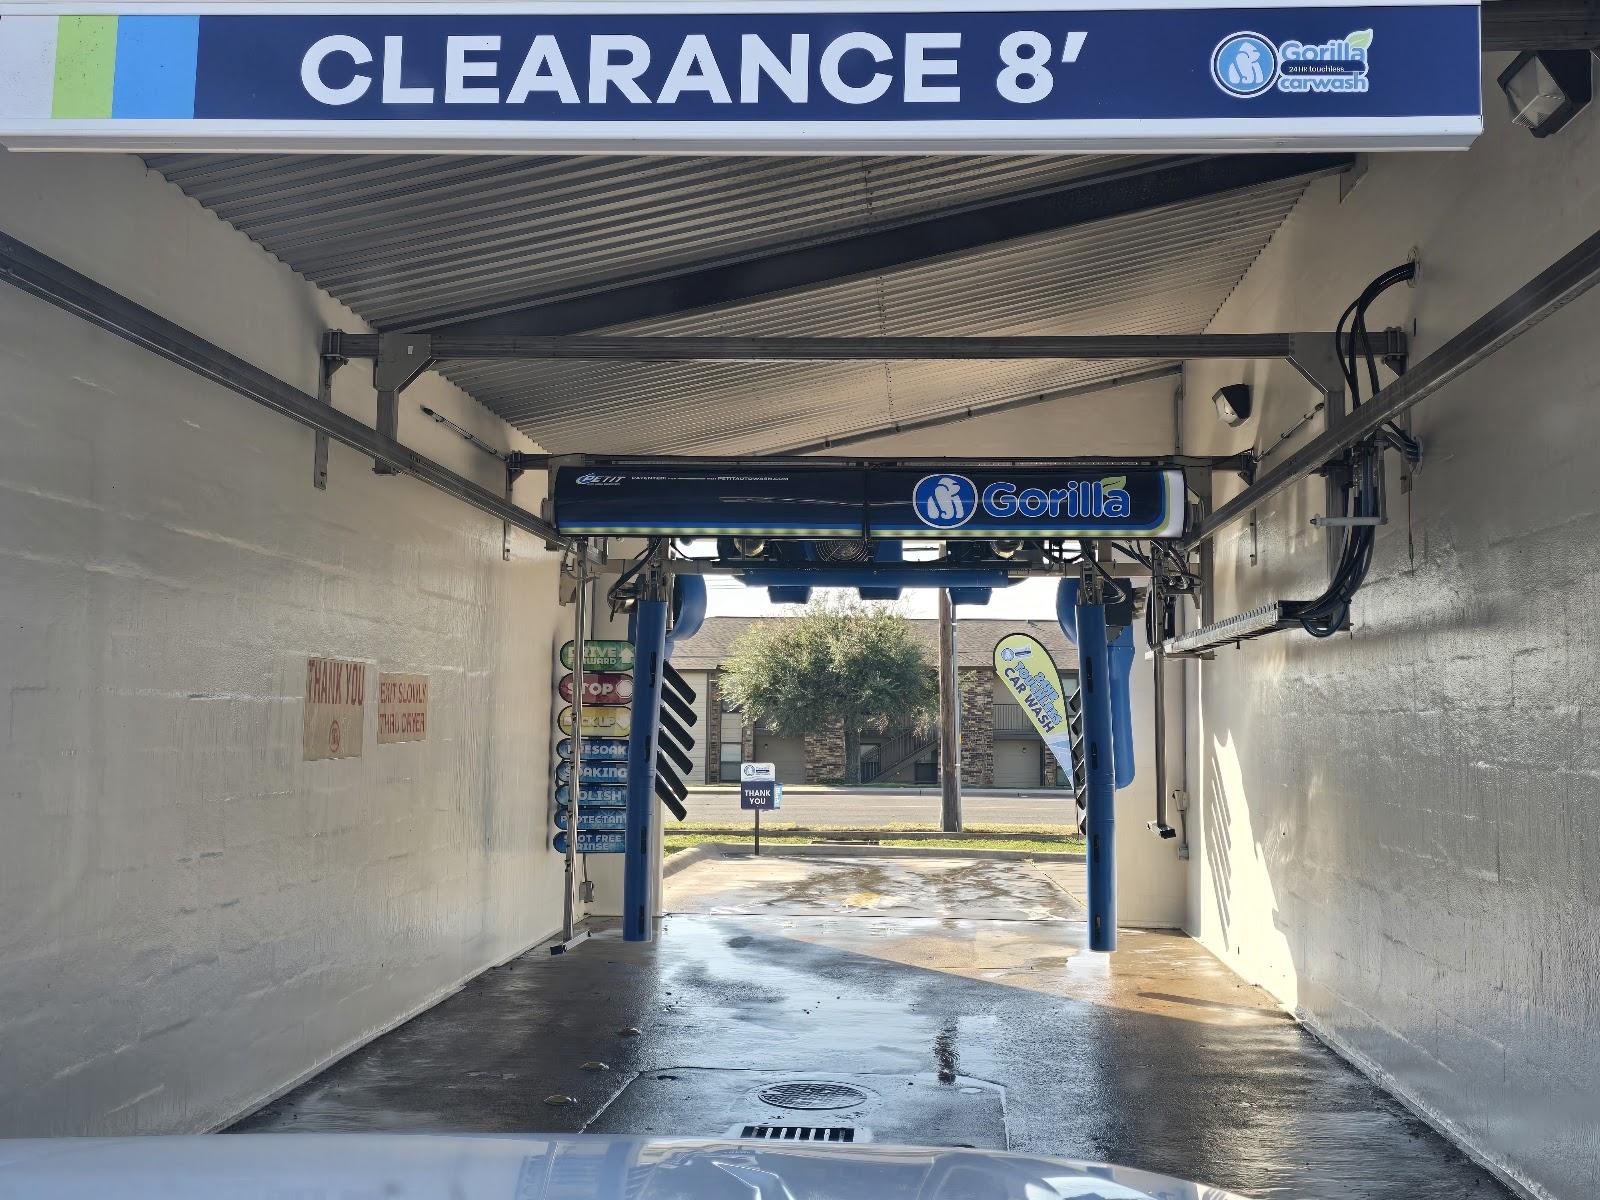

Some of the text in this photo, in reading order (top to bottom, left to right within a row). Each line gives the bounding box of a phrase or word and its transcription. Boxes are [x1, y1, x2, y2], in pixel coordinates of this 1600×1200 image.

[1281, 41, 1366, 61] Gorilla
[300, 32, 962, 106] CLEARANCE
[1309, 64, 1345, 73] touchless
[1280, 71, 1367, 91] carwash
[582, 475, 626, 483] PETIT
[982, 481, 1132, 518] Gorilla
[308, 660, 366, 706] THANK YOU
[380, 682, 397, 703] EXIT
[1004, 667, 1027, 694] CAR
[1024, 694, 1056, 733] WASH
[379, 712, 425, 734] THRU DRYER
[578, 790, 622, 801] OLISH
[744, 789, 771, 797] THANK
[749, 797, 766, 805] YOU
[560, 815, 627, 824] POTECTANT
[595, 834, 621, 843] FREE
